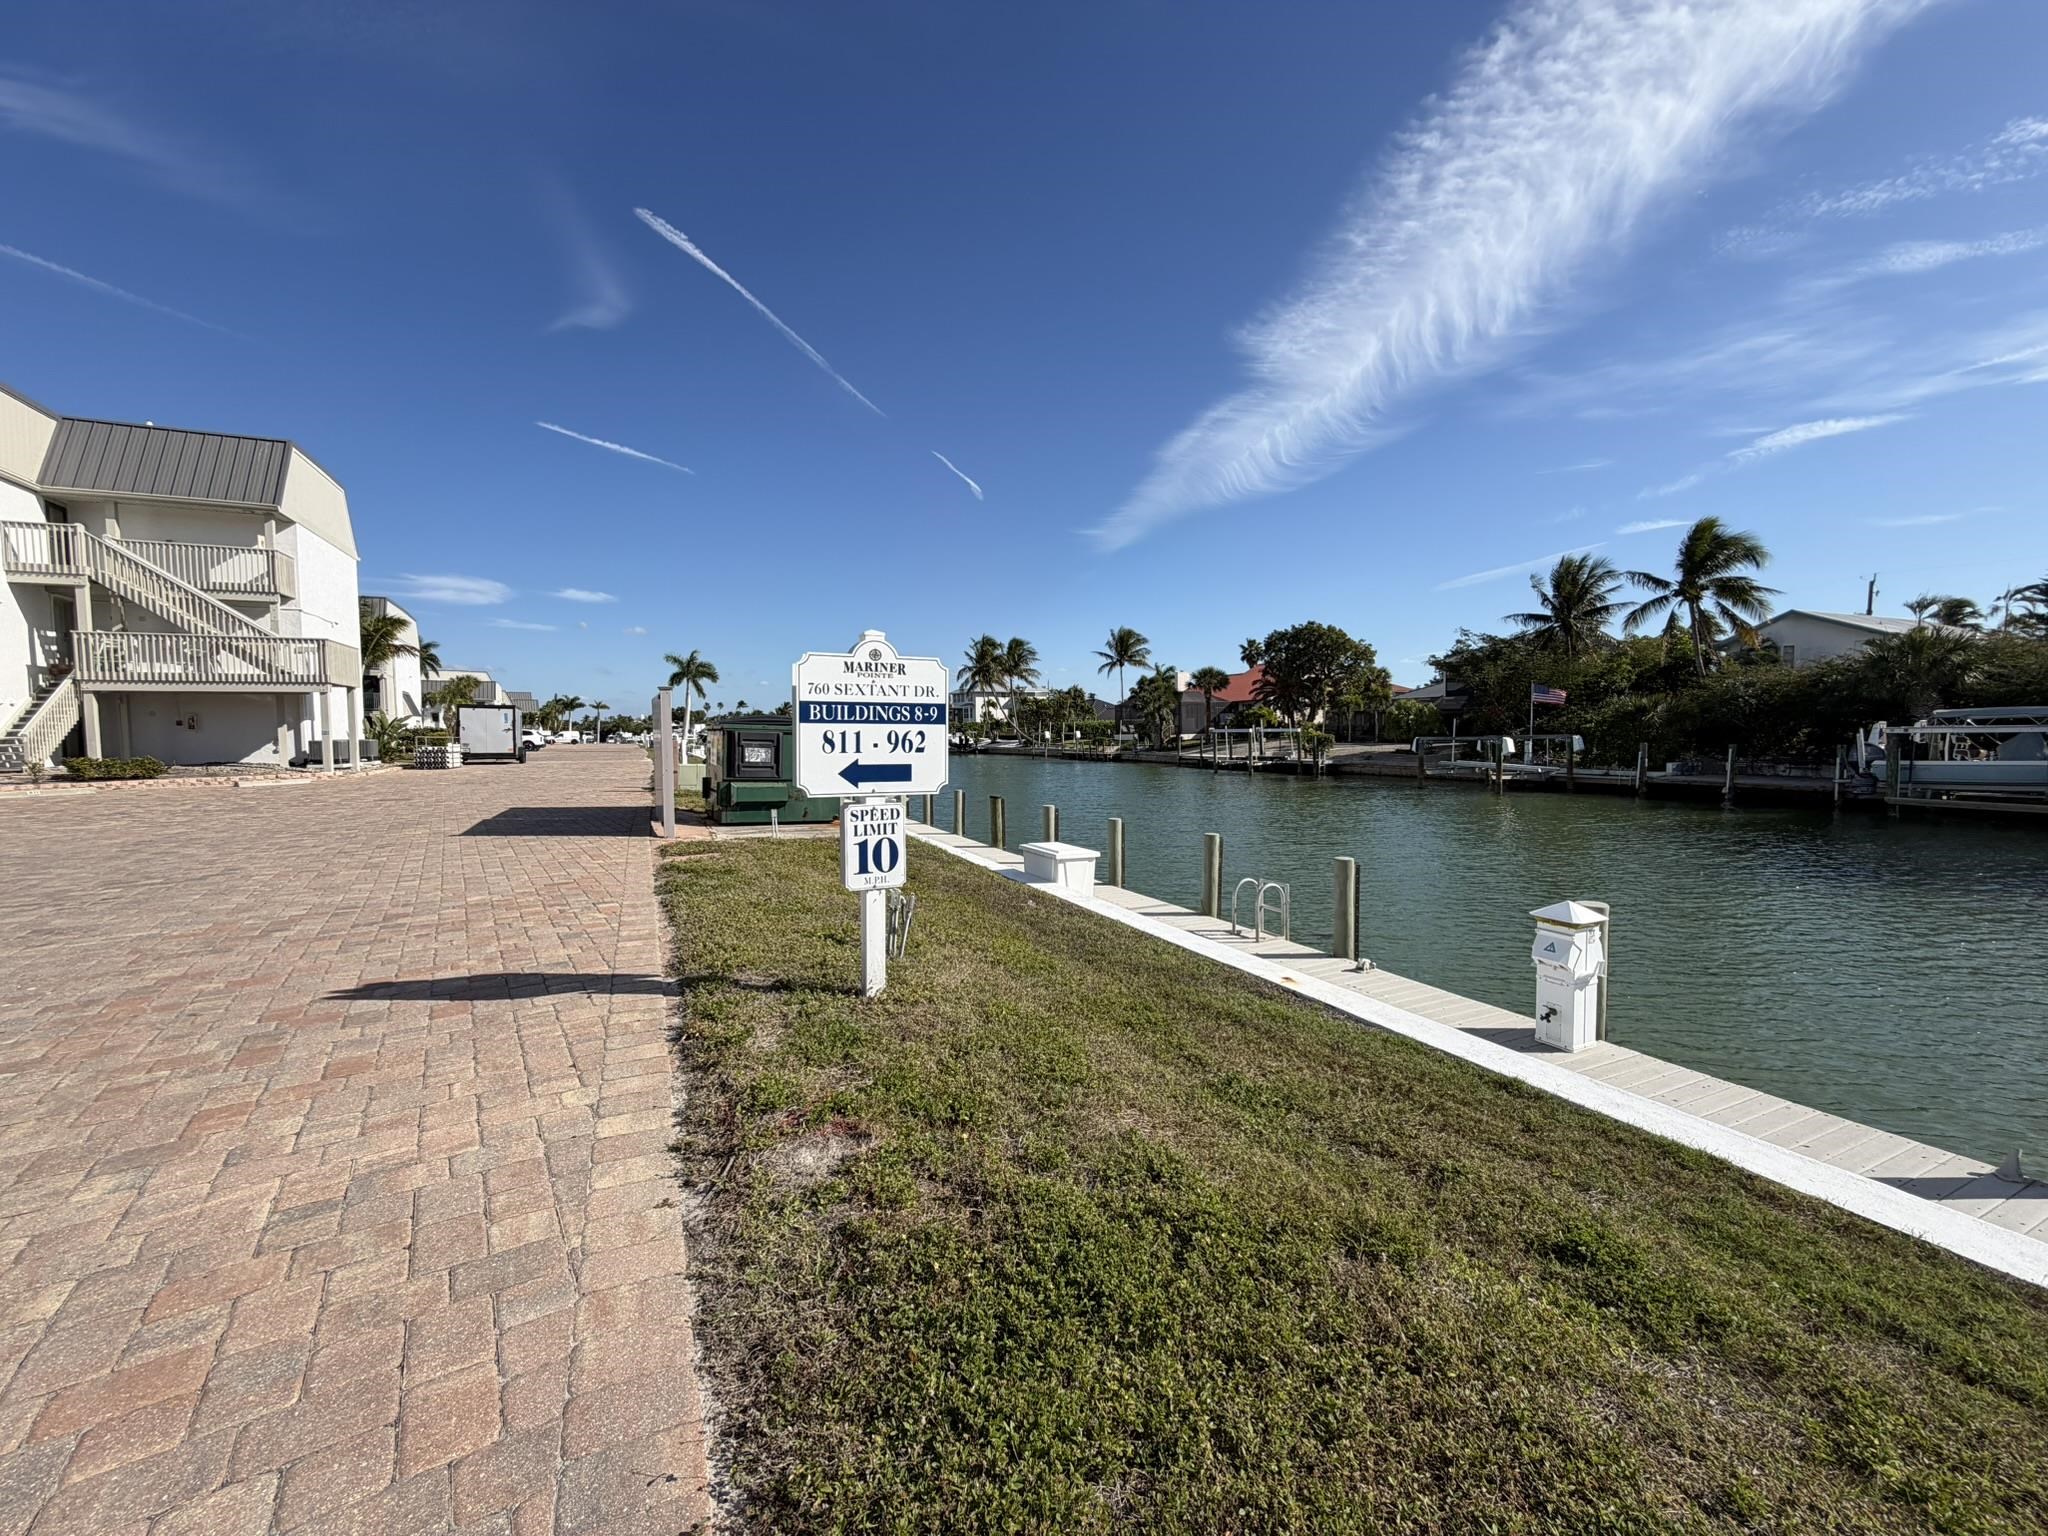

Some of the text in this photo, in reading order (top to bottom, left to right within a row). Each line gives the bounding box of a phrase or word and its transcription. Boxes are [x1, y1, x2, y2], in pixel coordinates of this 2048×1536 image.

[843, 661, 906, 676] MARINER
[808, 682, 940, 698] 760 SEXTANT DR.
[810, 704, 938, 721] BUILDINGS 8-9
[822, 730, 863, 754] 811
[886, 730, 926, 754] 962
[850, 808, 900, 822] SPEED
[853, 822, 898, 837] LIMIT
[853, 837, 899, 875] 10
